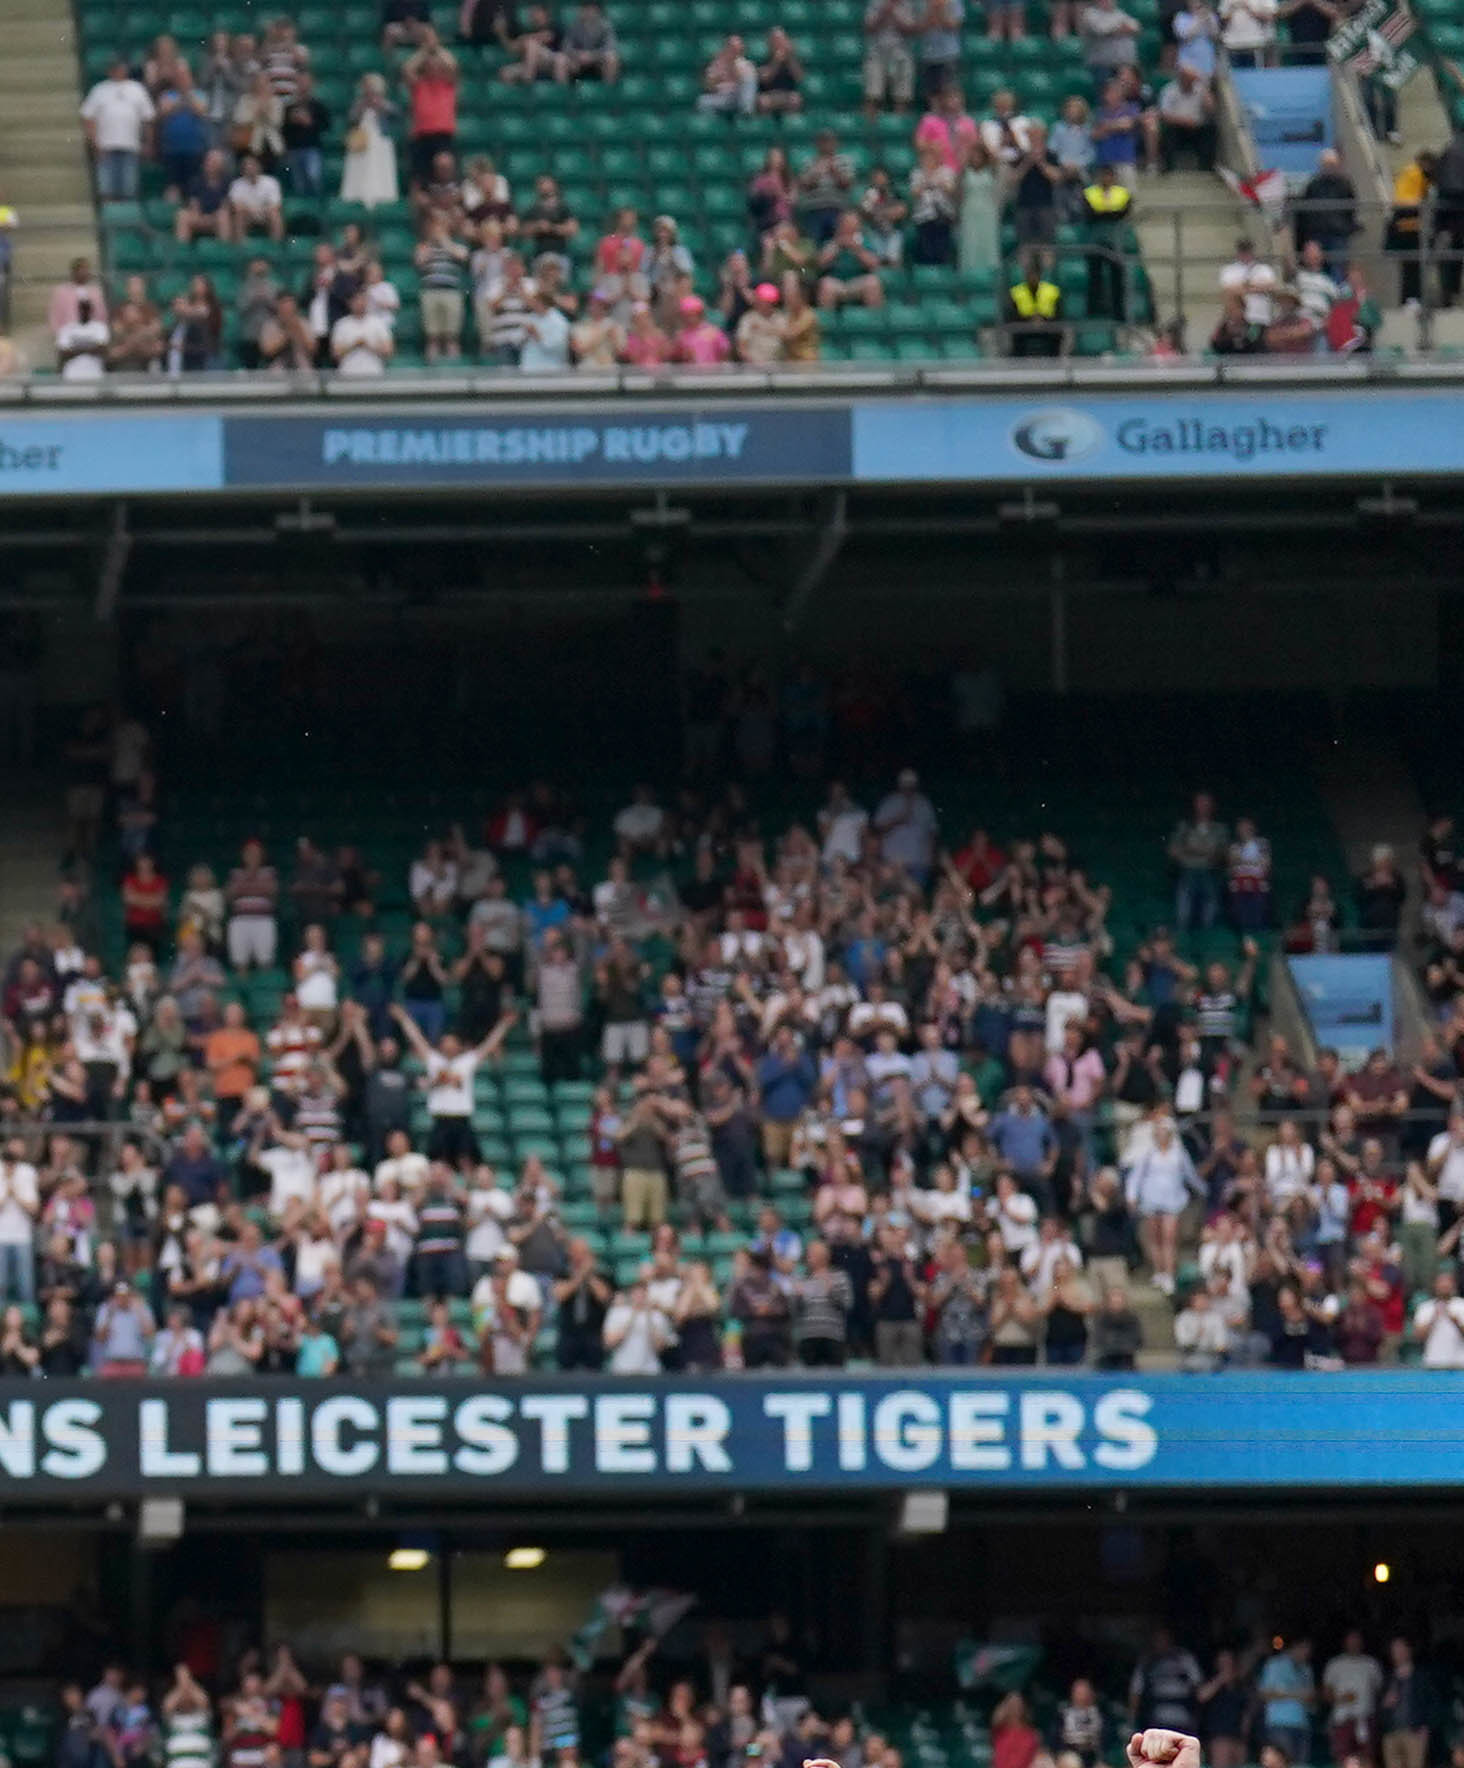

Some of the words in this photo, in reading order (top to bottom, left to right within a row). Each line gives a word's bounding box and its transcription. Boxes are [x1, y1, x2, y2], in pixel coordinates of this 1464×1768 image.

[323, 427, 599, 465] PREMIERSHIP
[607, 422, 748, 461] RUGBY
[1117, 415, 1329, 459] Gallagher
[140, 1394, 732, 1480] LEICESTER
[767, 1389, 1158, 1475] TIGERS
